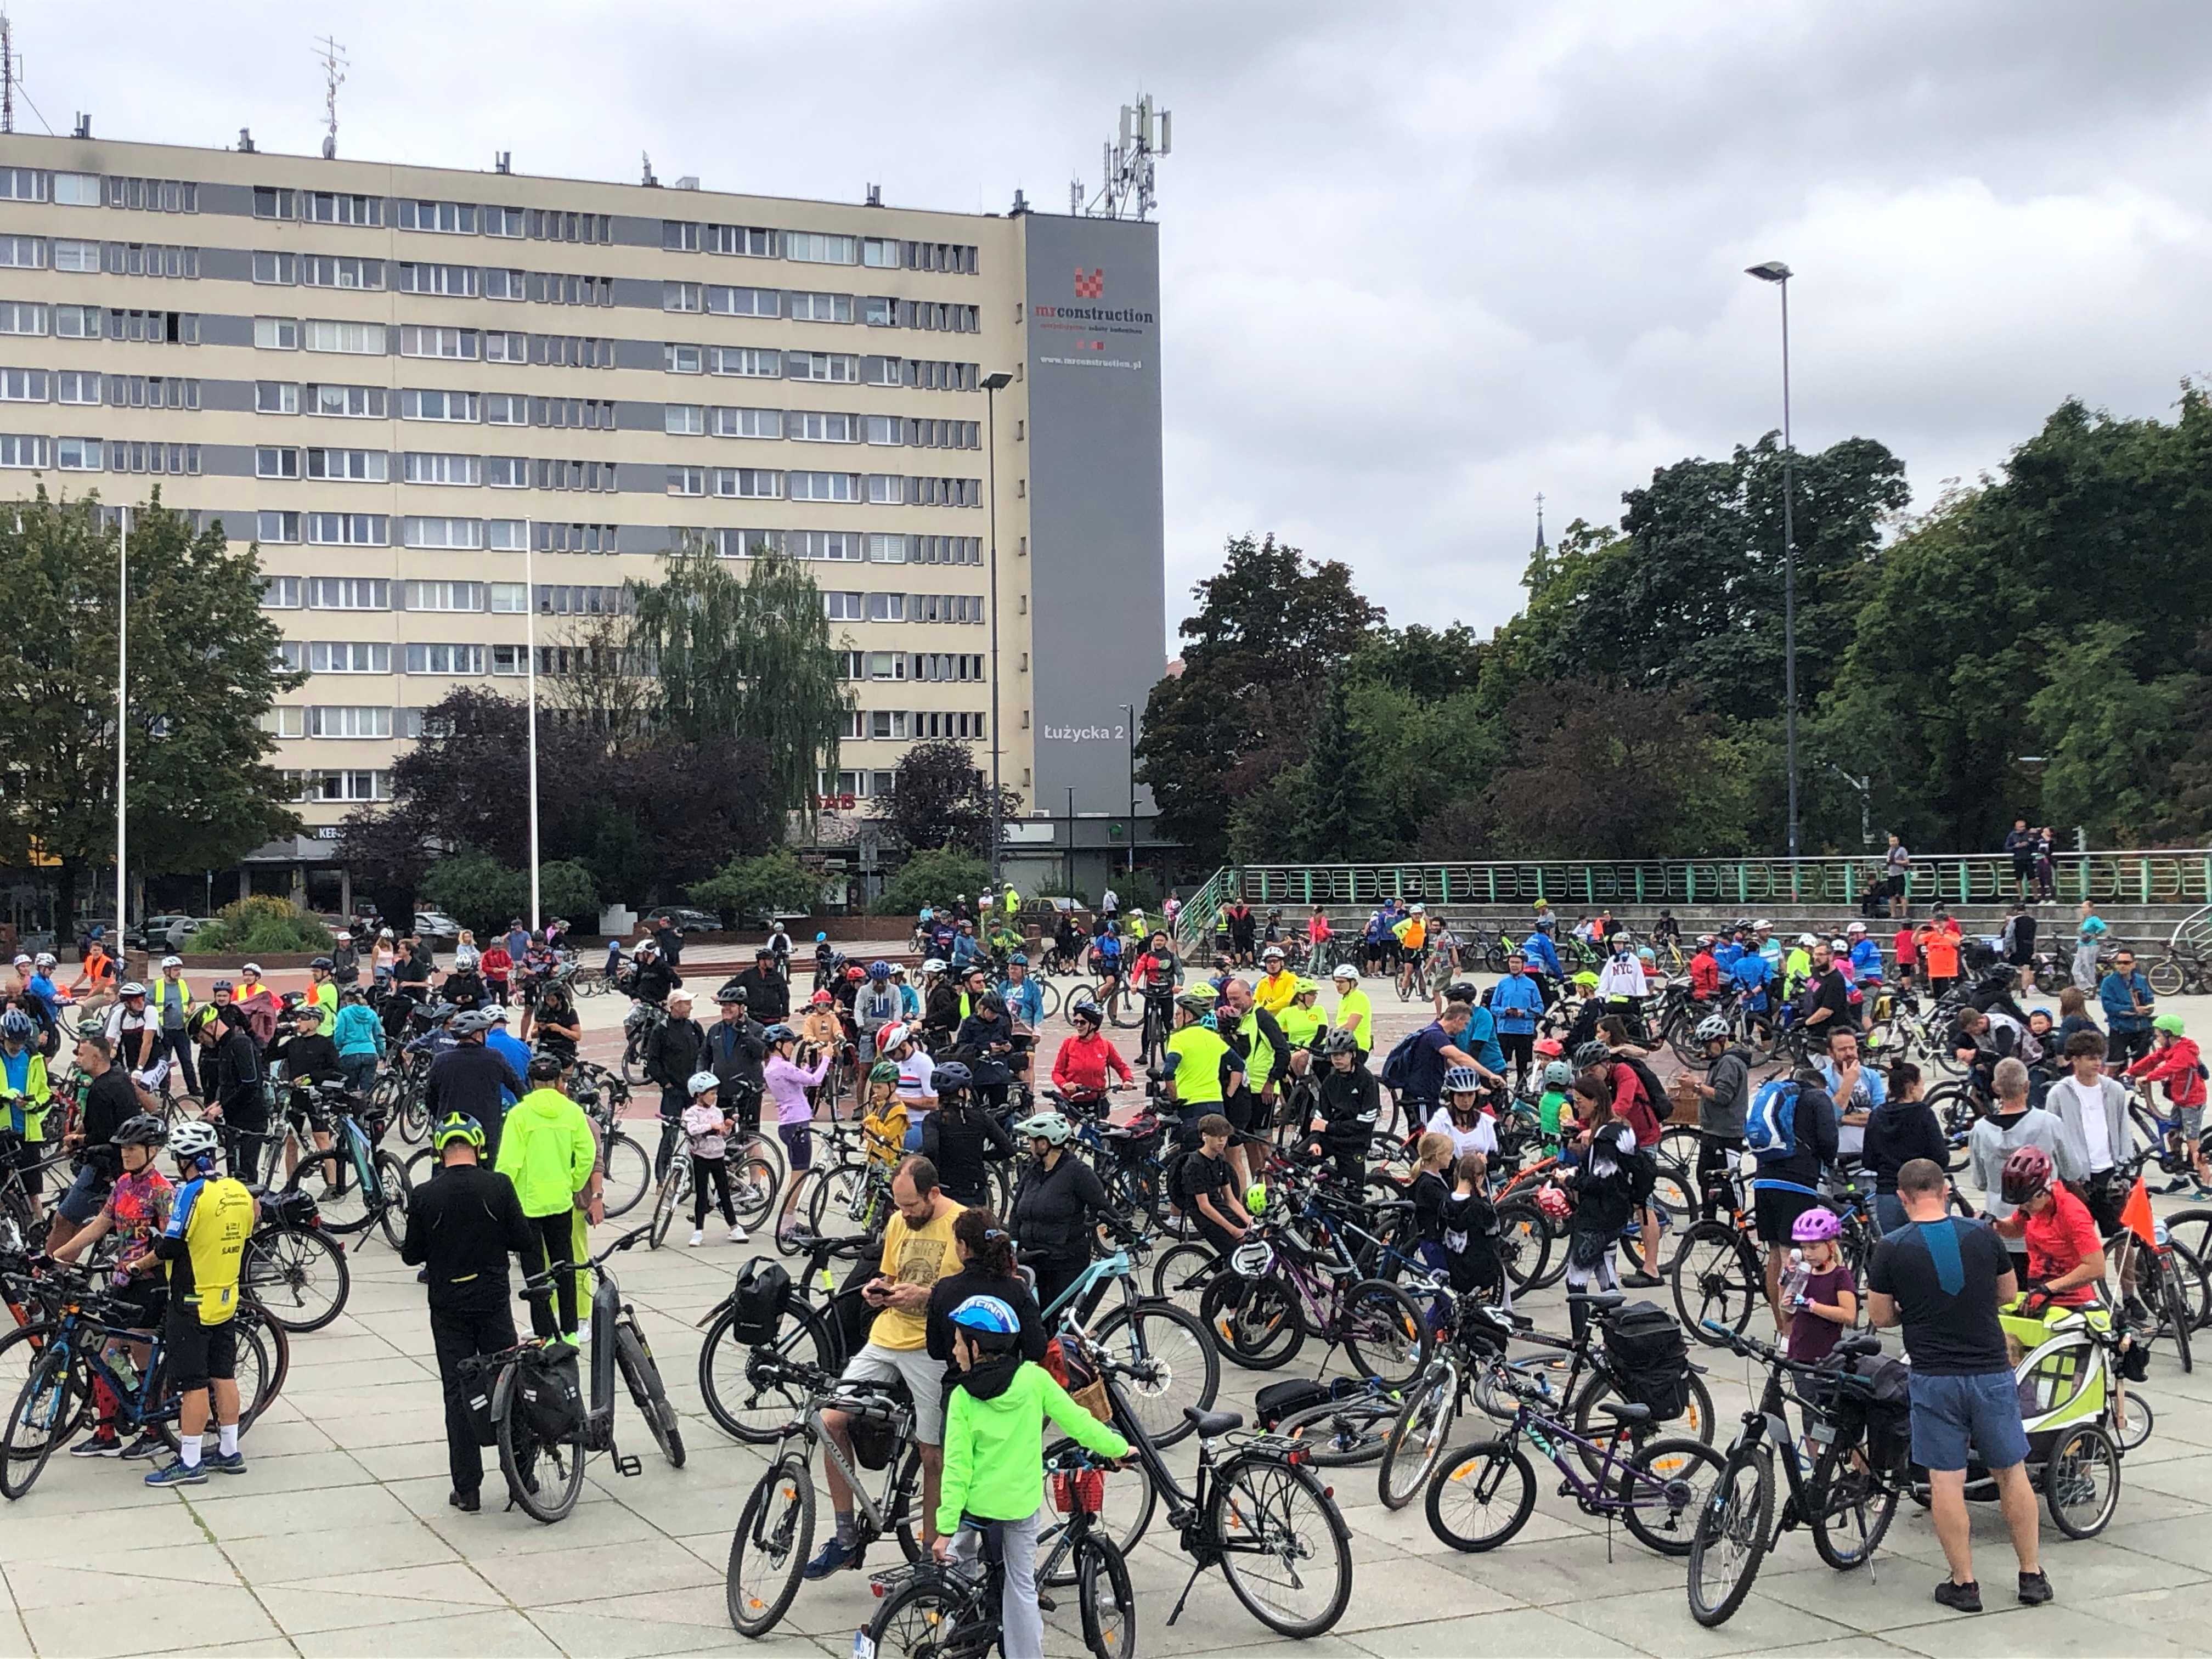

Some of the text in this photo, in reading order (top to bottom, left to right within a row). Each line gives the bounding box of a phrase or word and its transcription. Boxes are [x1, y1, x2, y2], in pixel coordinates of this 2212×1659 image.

[1035, 305, 1153, 323] mrconstruction
[1040, 356, 1142, 370] www.mrconstruction.pl
[1045, 725, 1124, 742] Łużycka 2
[1613, 963, 1633, 976] NYC
